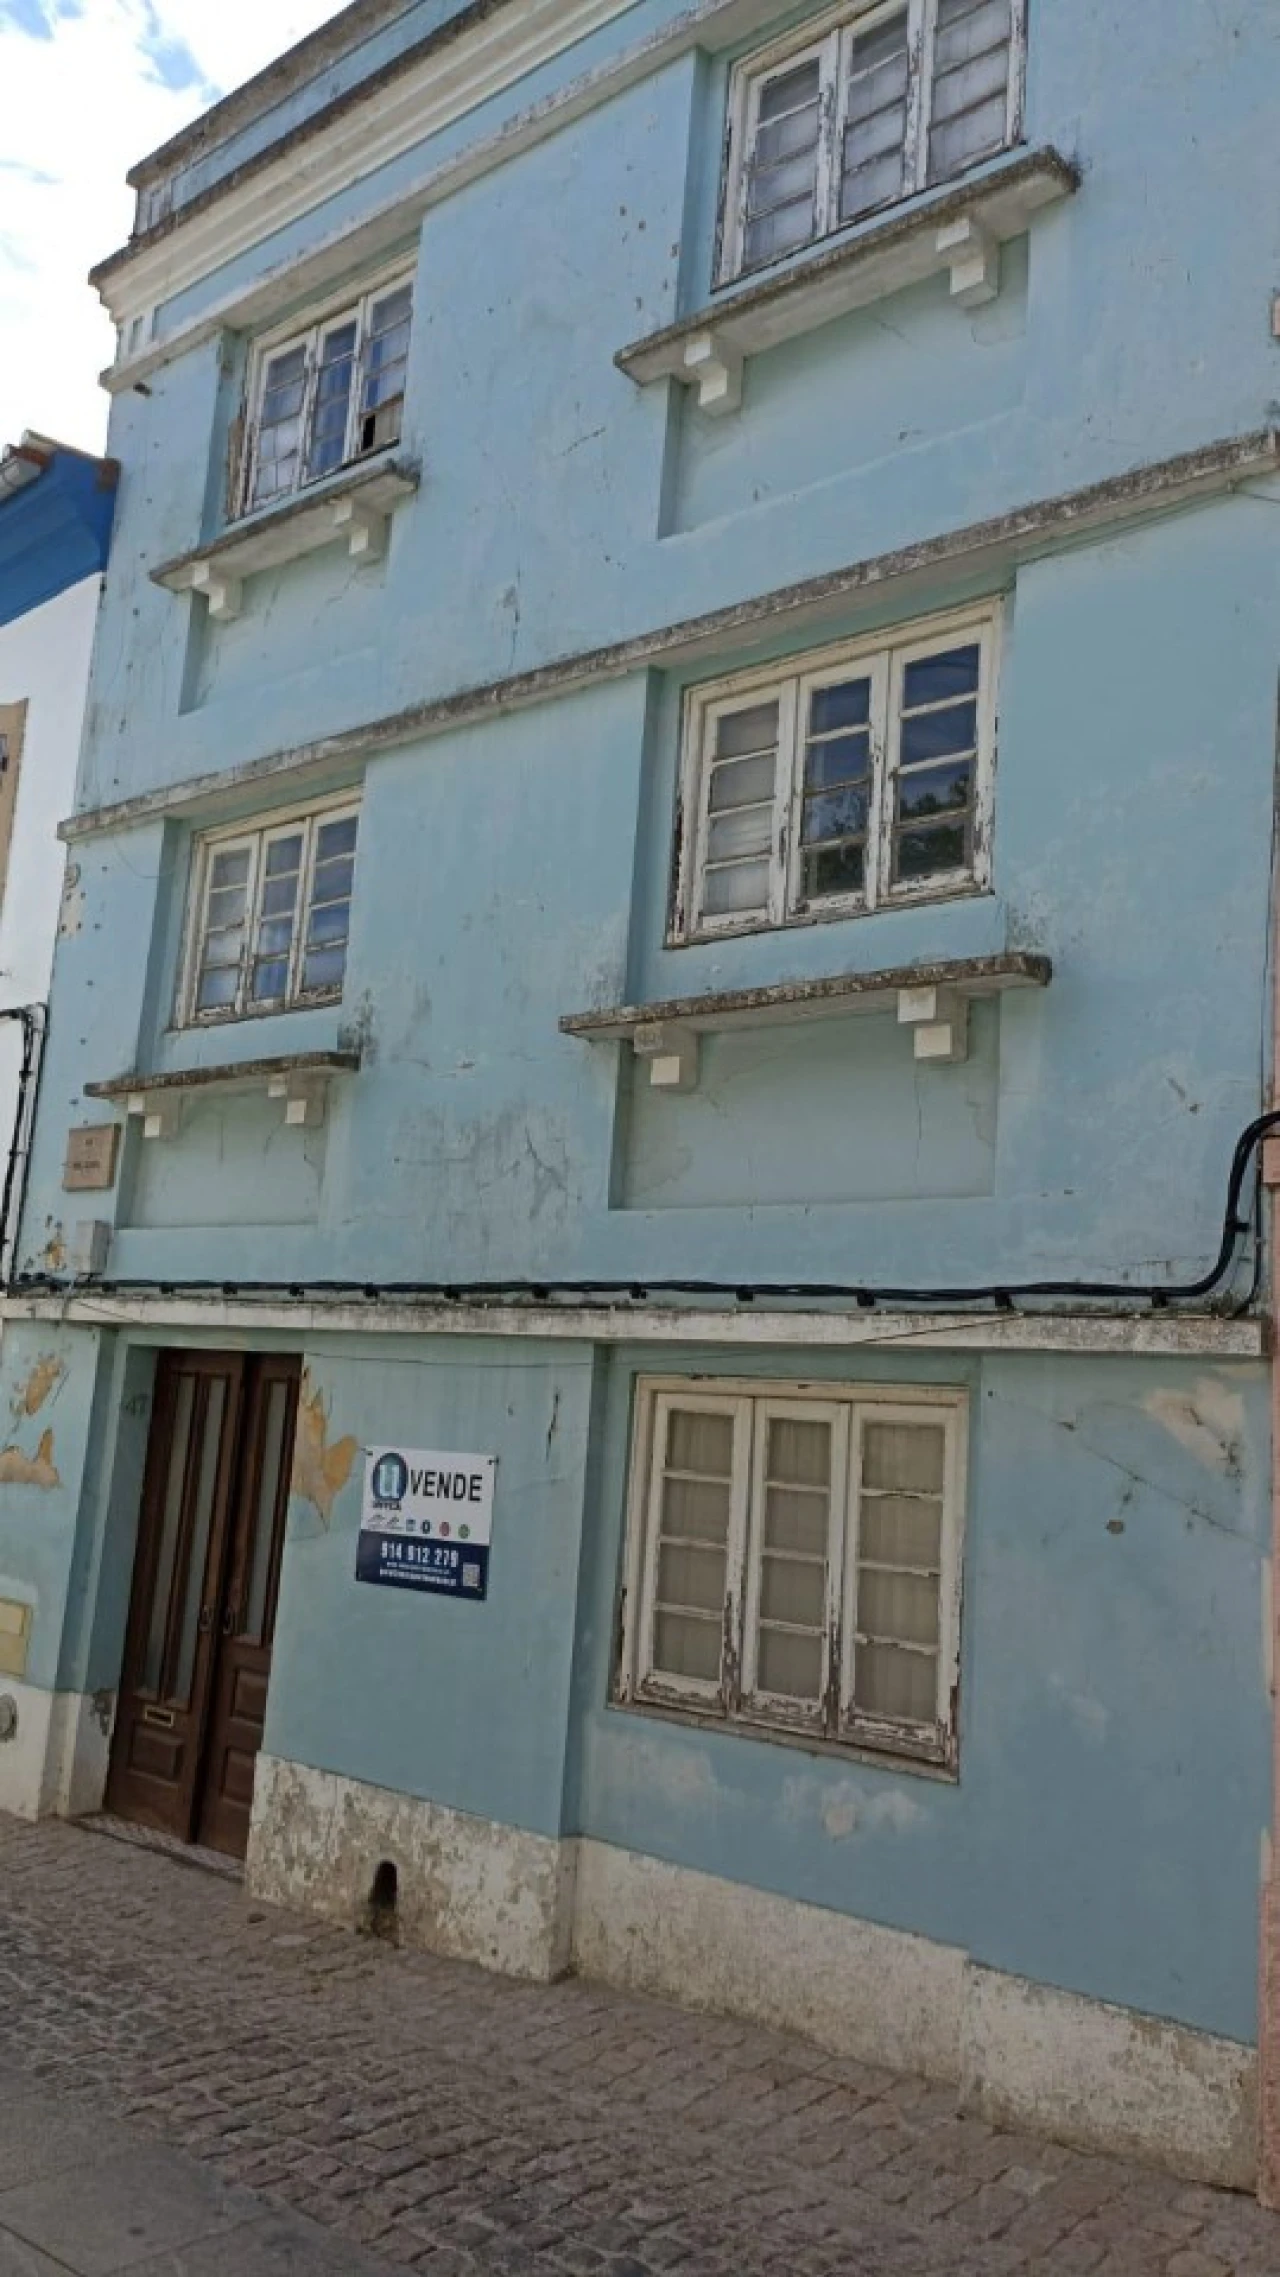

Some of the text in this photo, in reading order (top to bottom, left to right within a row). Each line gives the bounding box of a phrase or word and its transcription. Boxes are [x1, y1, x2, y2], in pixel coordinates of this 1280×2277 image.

[410, 1469, 483, 1502] VENDE
[381, 1540, 402, 1560] 914
[407, 1545, 430, 1563] 912
